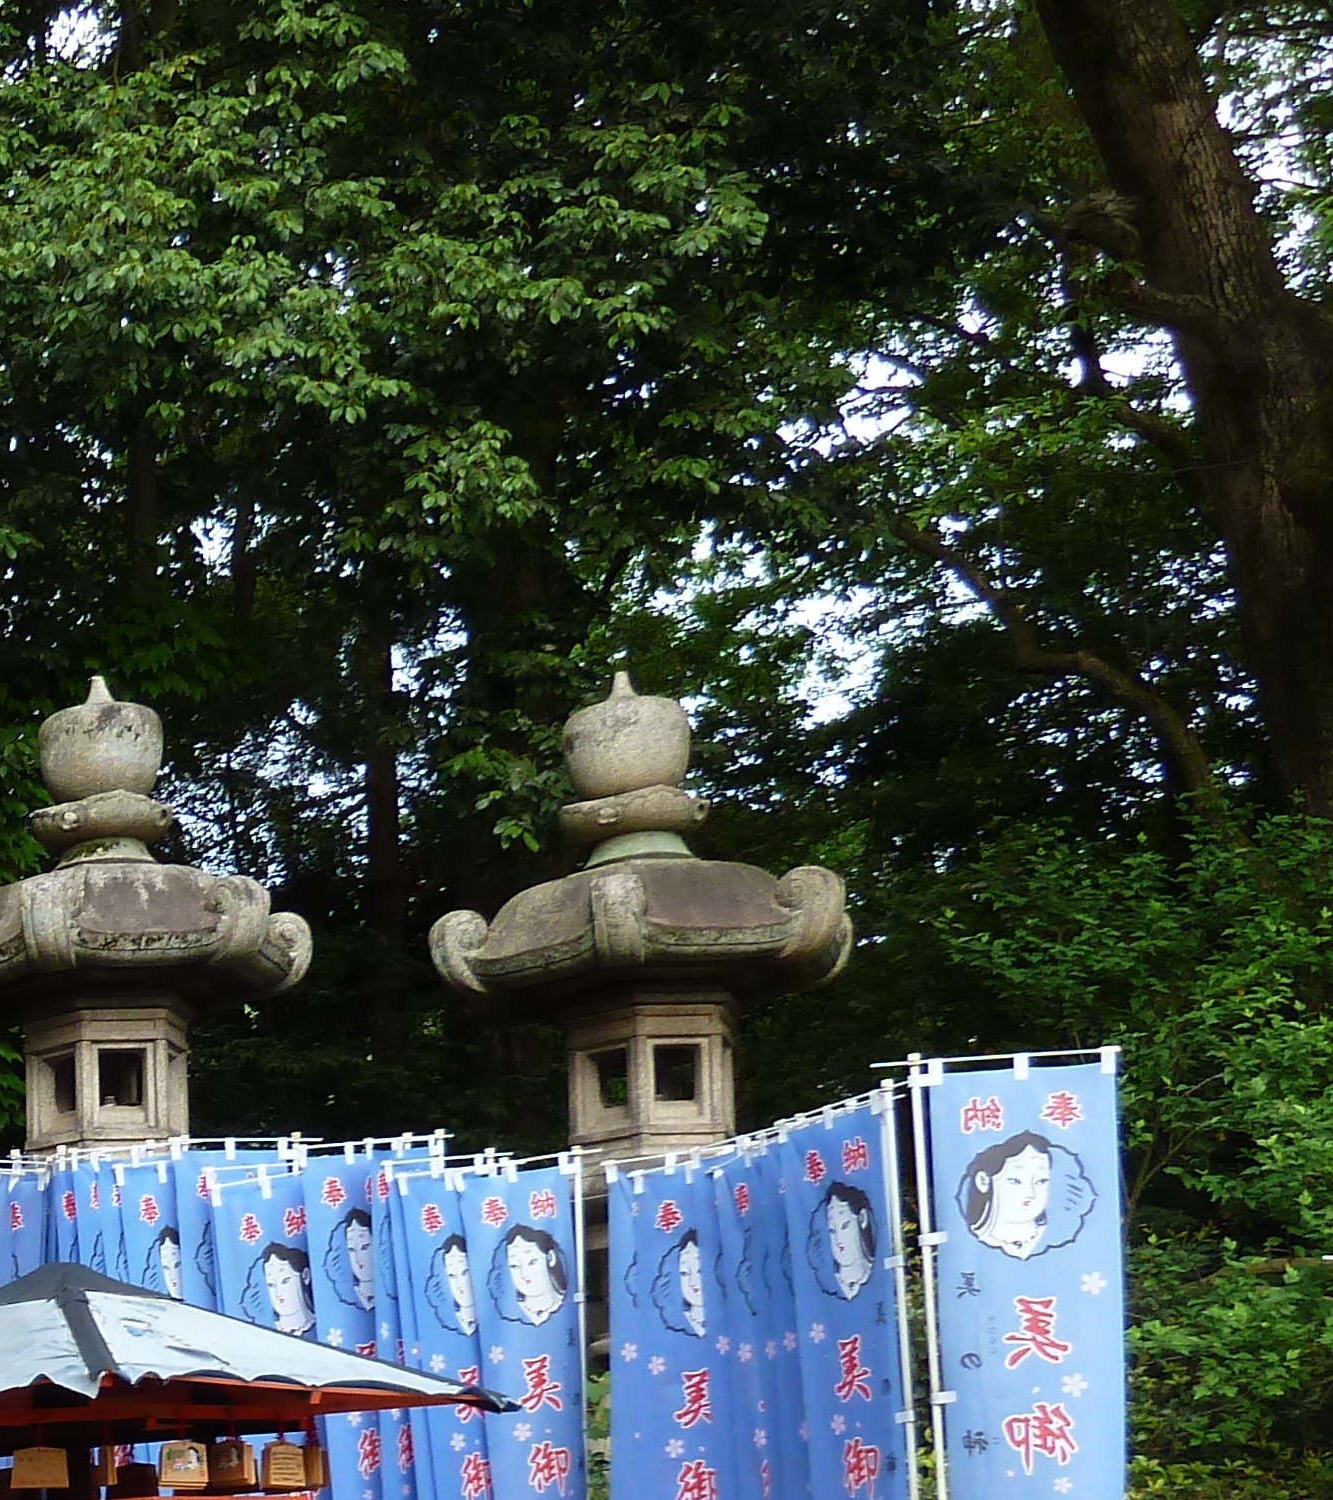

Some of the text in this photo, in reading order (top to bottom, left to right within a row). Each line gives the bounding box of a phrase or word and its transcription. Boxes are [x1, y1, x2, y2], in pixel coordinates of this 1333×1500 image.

[804, 1137, 869, 1185] 奉納
[140, 1195, 161, 1225] 奉
[422, 1203, 445, 1234] 奉
[481, 1190, 558, 1228] 奉納
[655, 1200, 683, 1234] 奉
